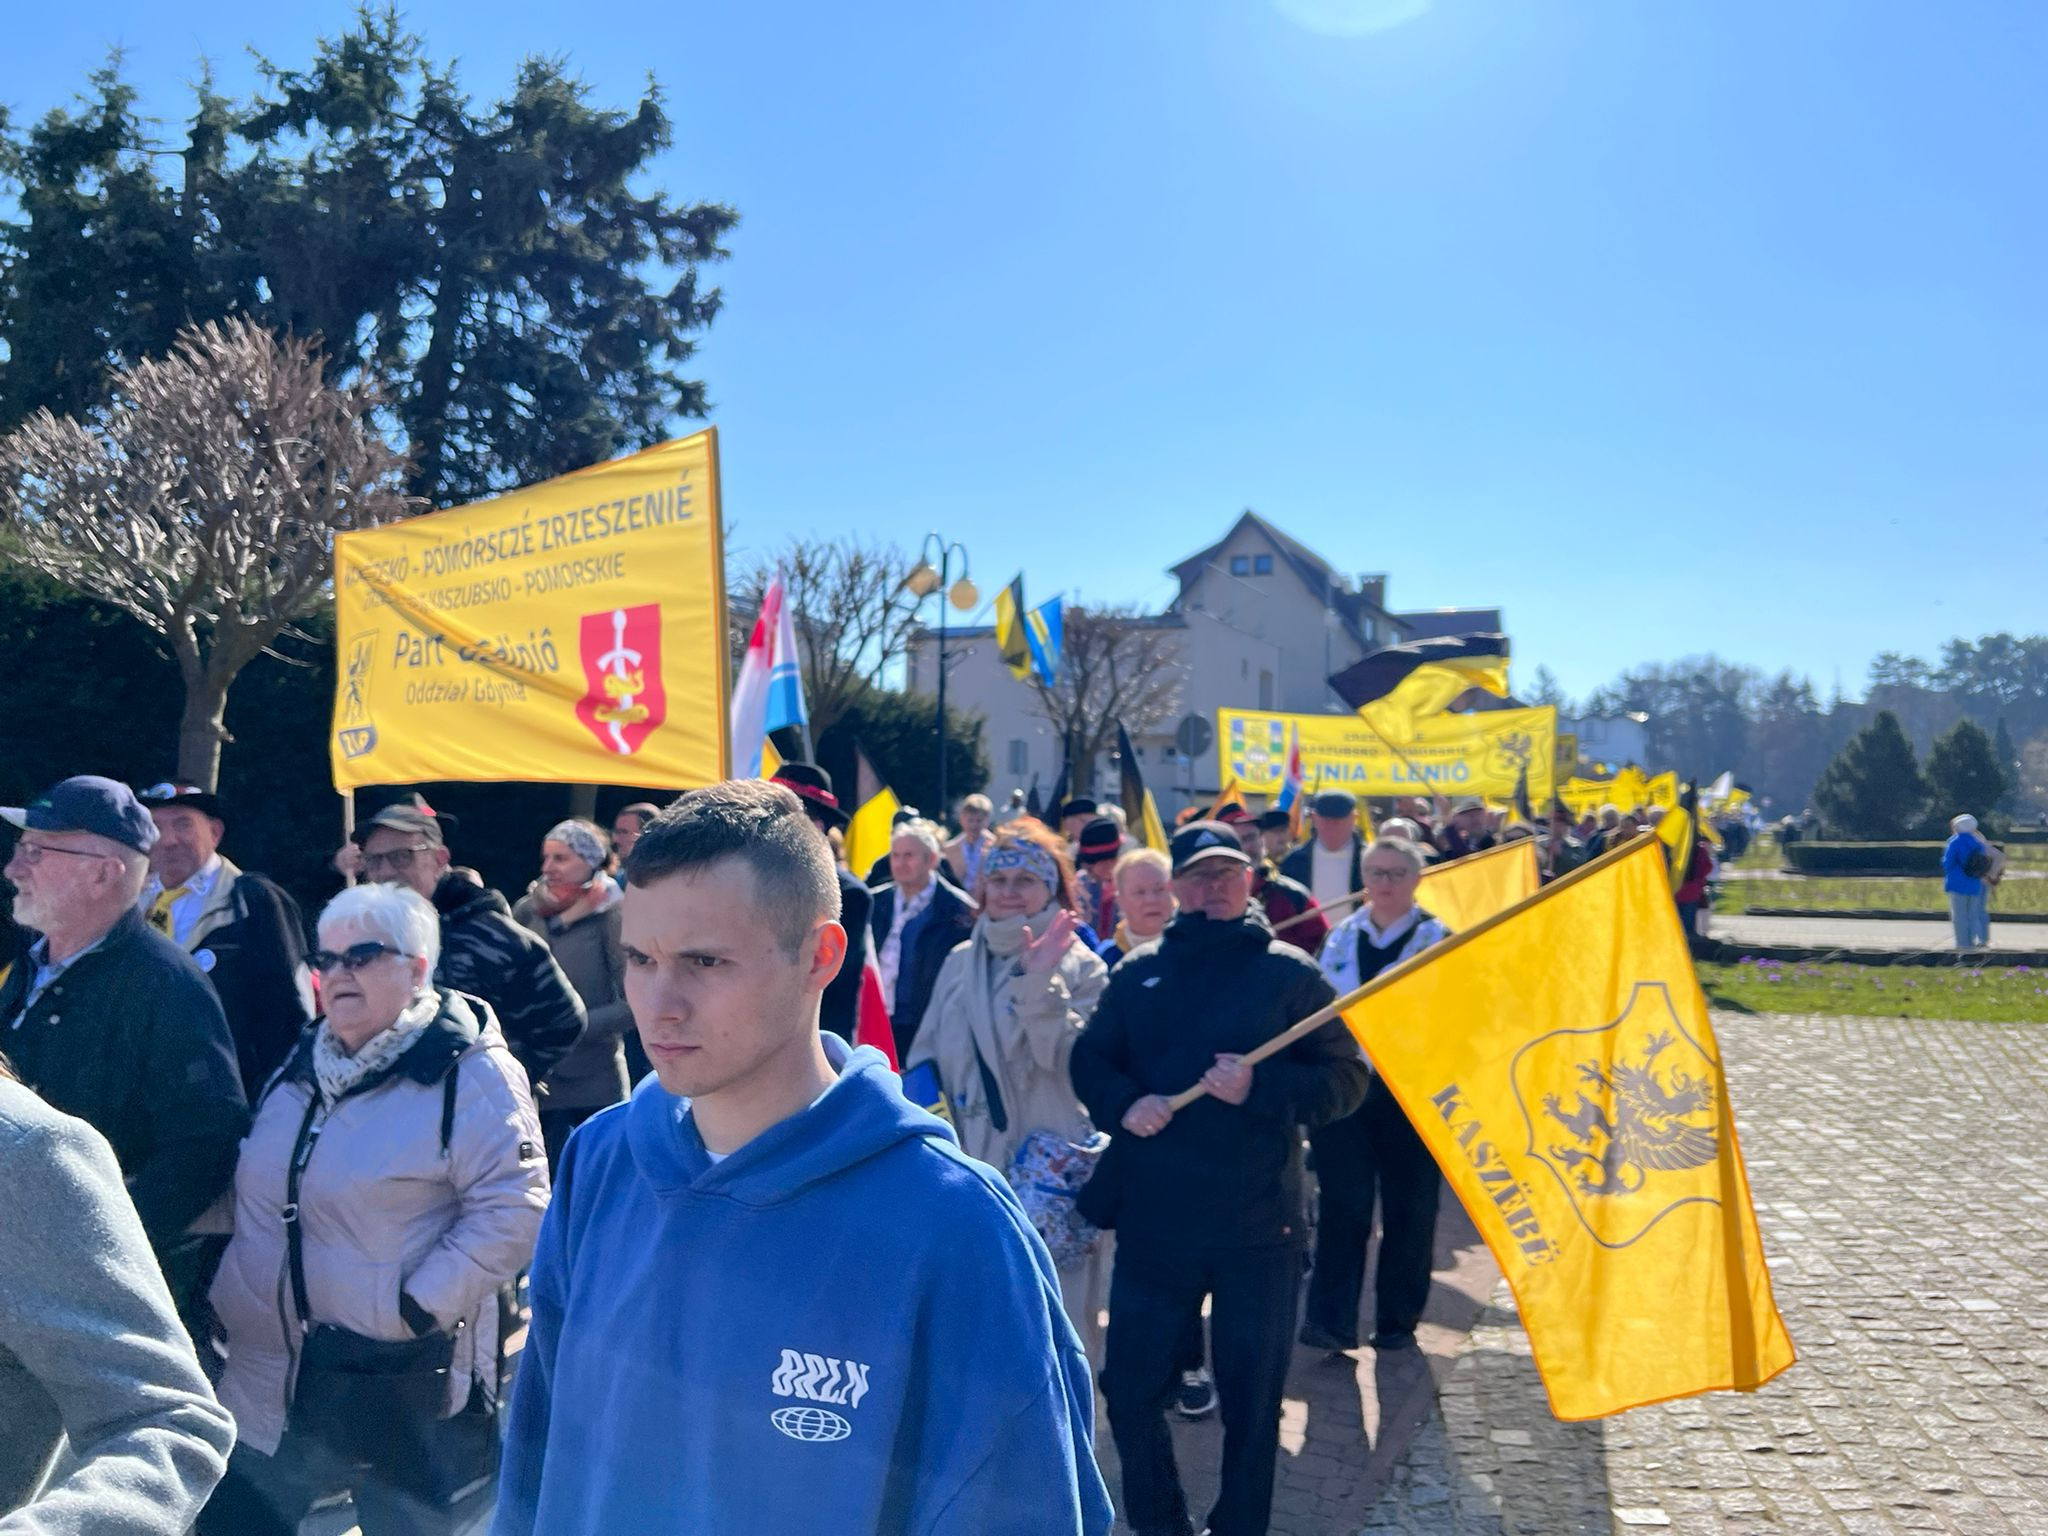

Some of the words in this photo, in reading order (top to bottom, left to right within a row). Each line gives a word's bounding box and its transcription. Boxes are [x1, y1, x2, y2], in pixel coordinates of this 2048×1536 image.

[537, 468, 694, 550] ZRZESZENIÉ
[525, 552, 626, 596] POMORSKIE
[393, 631, 445, 670] Part
[1301, 763, 1368, 782] LINIA
[1430, 1083, 1561, 1267] KASZËBË
